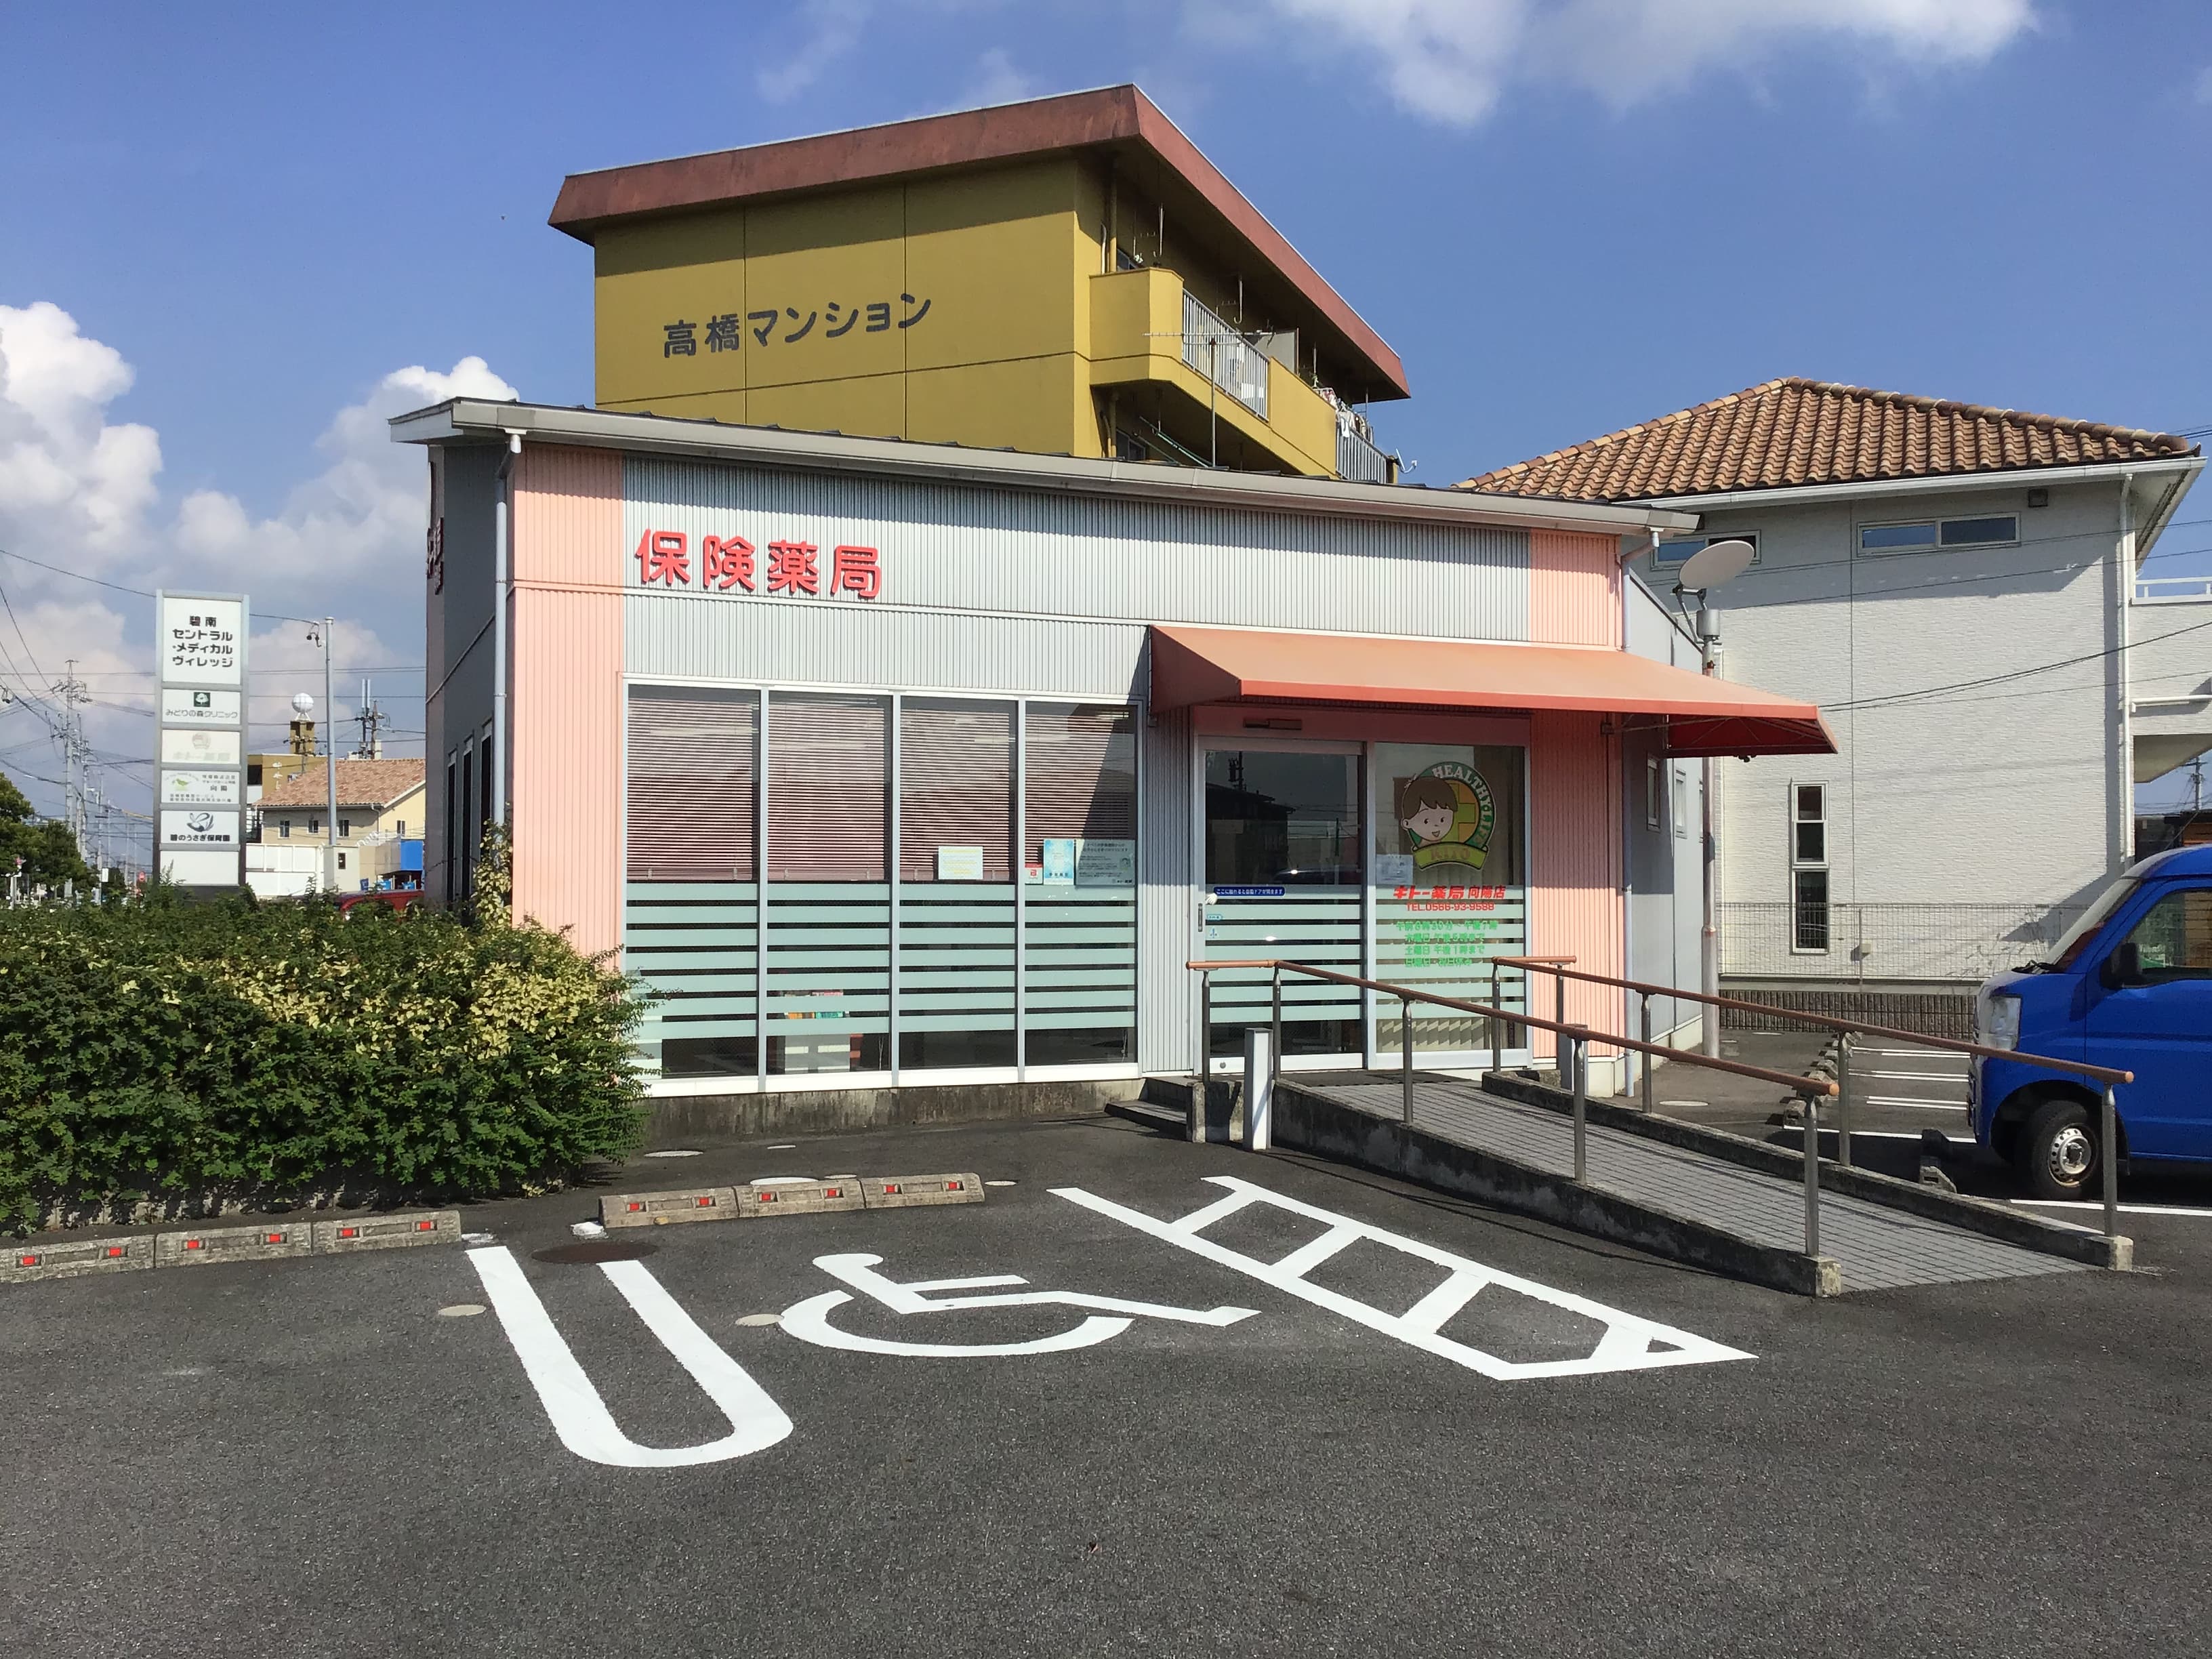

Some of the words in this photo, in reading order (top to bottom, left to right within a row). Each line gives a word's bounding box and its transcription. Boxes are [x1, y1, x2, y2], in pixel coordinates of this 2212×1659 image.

[663, 293, 932, 359] 高橋マンション
[635, 529, 881, 598] 保険薬局
[172, 629, 232, 641] セントラル
[172, 655, 233, 668] ヴィレッジ
[165, 709, 238, 718] みどりの森クリニック
[1393, 885, 1465, 899] キトー薬局
[1468, 885, 1506, 899] 向陽店
